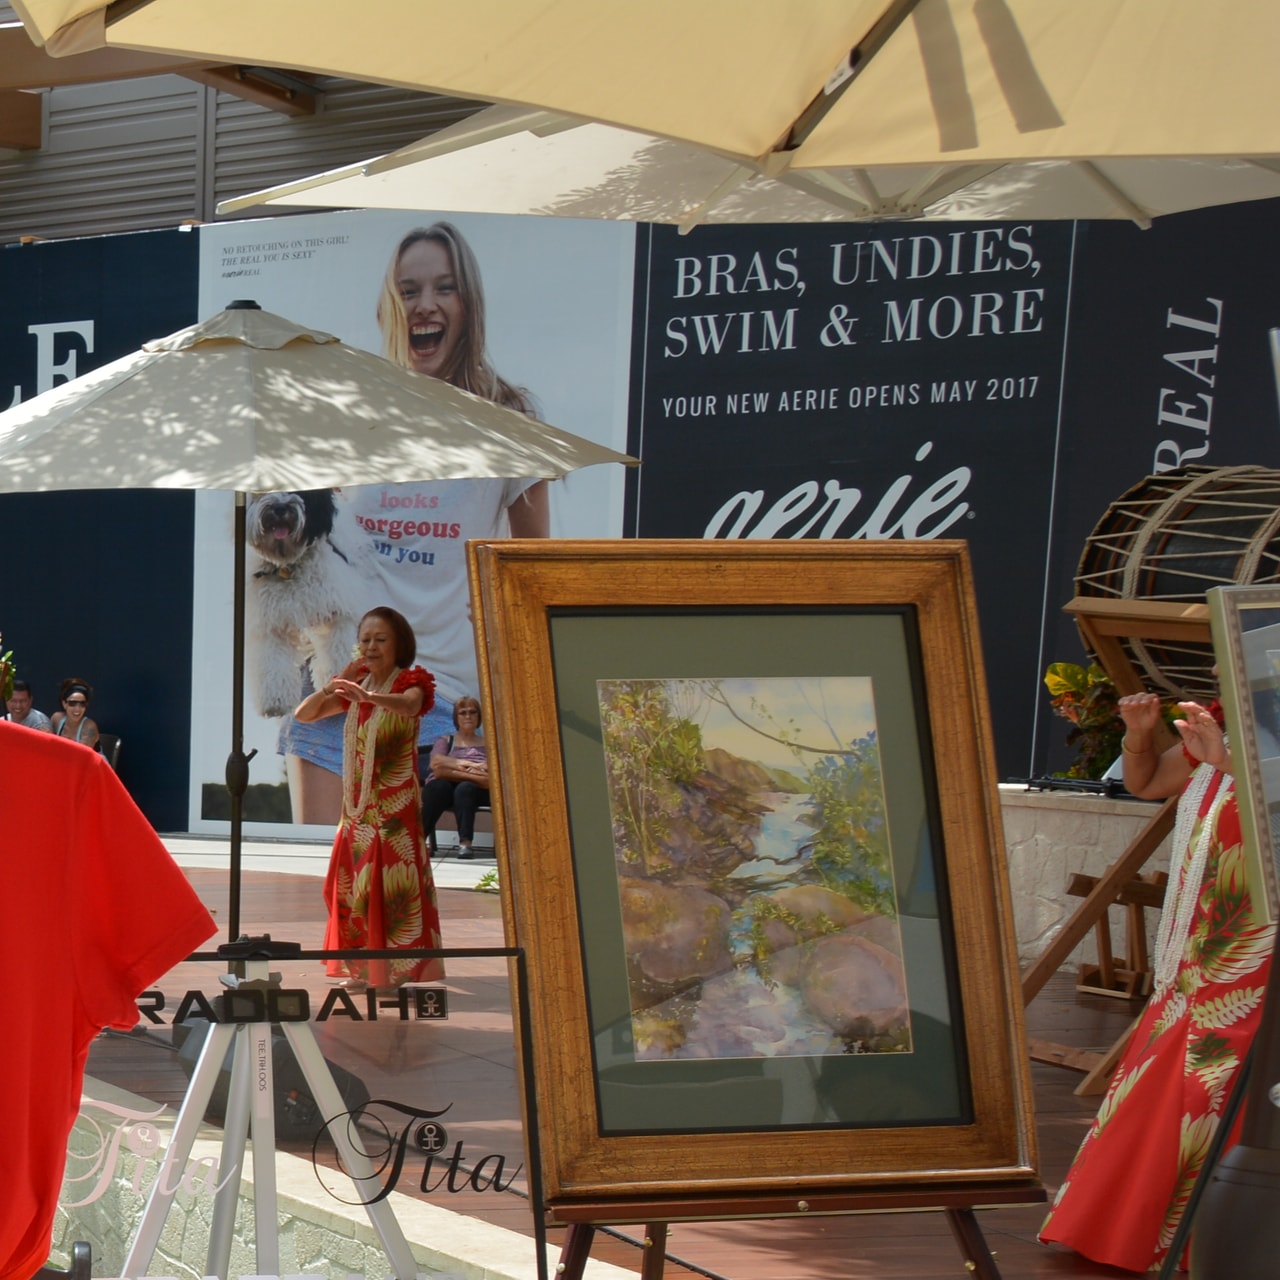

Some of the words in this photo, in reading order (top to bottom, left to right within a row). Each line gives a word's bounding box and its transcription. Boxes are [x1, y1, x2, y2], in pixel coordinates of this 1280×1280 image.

[221, 257, 238, 267] THE
[239, 255, 262, 265] REAL
[263, 253, 280, 263] YOU
[672, 247, 807, 298] BRAS,
[829, 225, 1042, 286] UNDIES,
[664, 308, 800, 358] SWIM
[819, 303, 860, 348] &
[880, 288, 1046, 344] MORE
[662, 395, 717, 418] YOUR
[726, 392, 770, 415] NEW
[778, 387, 839, 413] AERIE
[848, 382, 921, 408] OPENS
[930, 379, 978, 405] MAY
[986, 375, 1040, 402] 2017
[379, 491, 439, 509] looks
[395, 547, 435, 565] you
[135, 987, 411, 1025] RADDAH
[57, 1098, 239, 1208] Tita
[311, 1099, 526, 1207] Tita
